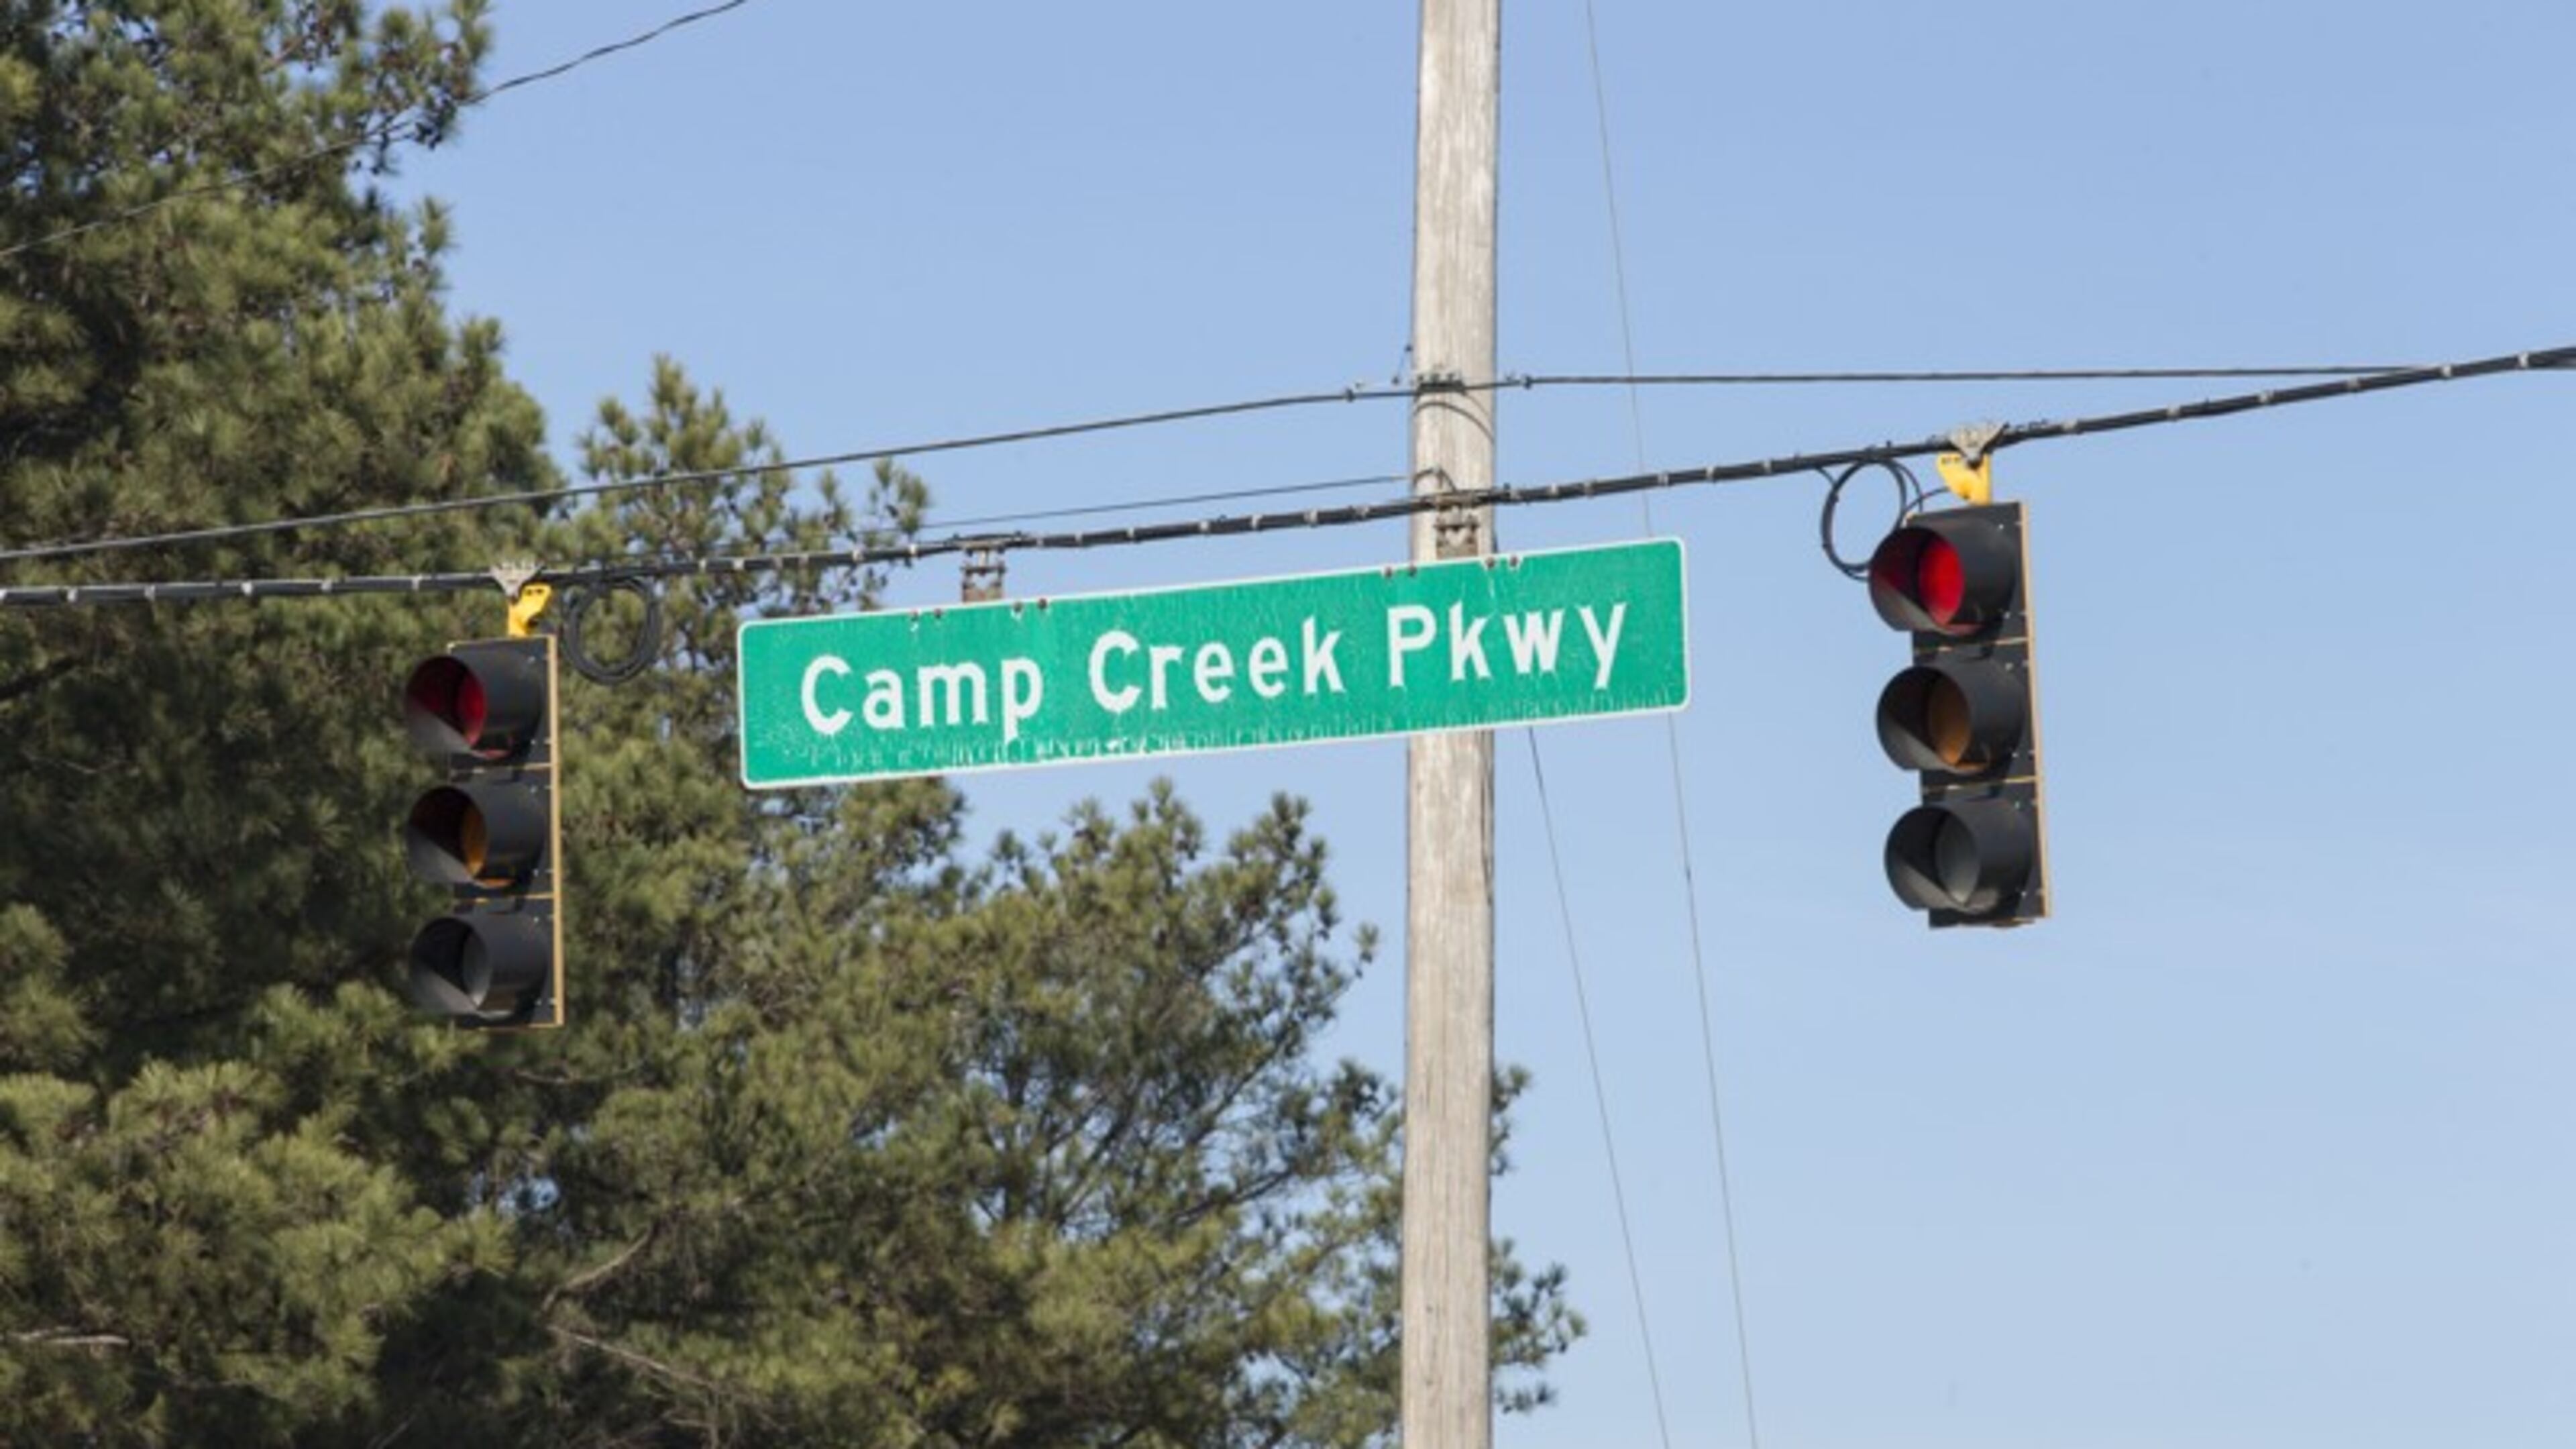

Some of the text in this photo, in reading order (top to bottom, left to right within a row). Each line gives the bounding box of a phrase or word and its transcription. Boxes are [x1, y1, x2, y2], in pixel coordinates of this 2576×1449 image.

[800, 601, 1627, 746] Camp Creek Pkwy
